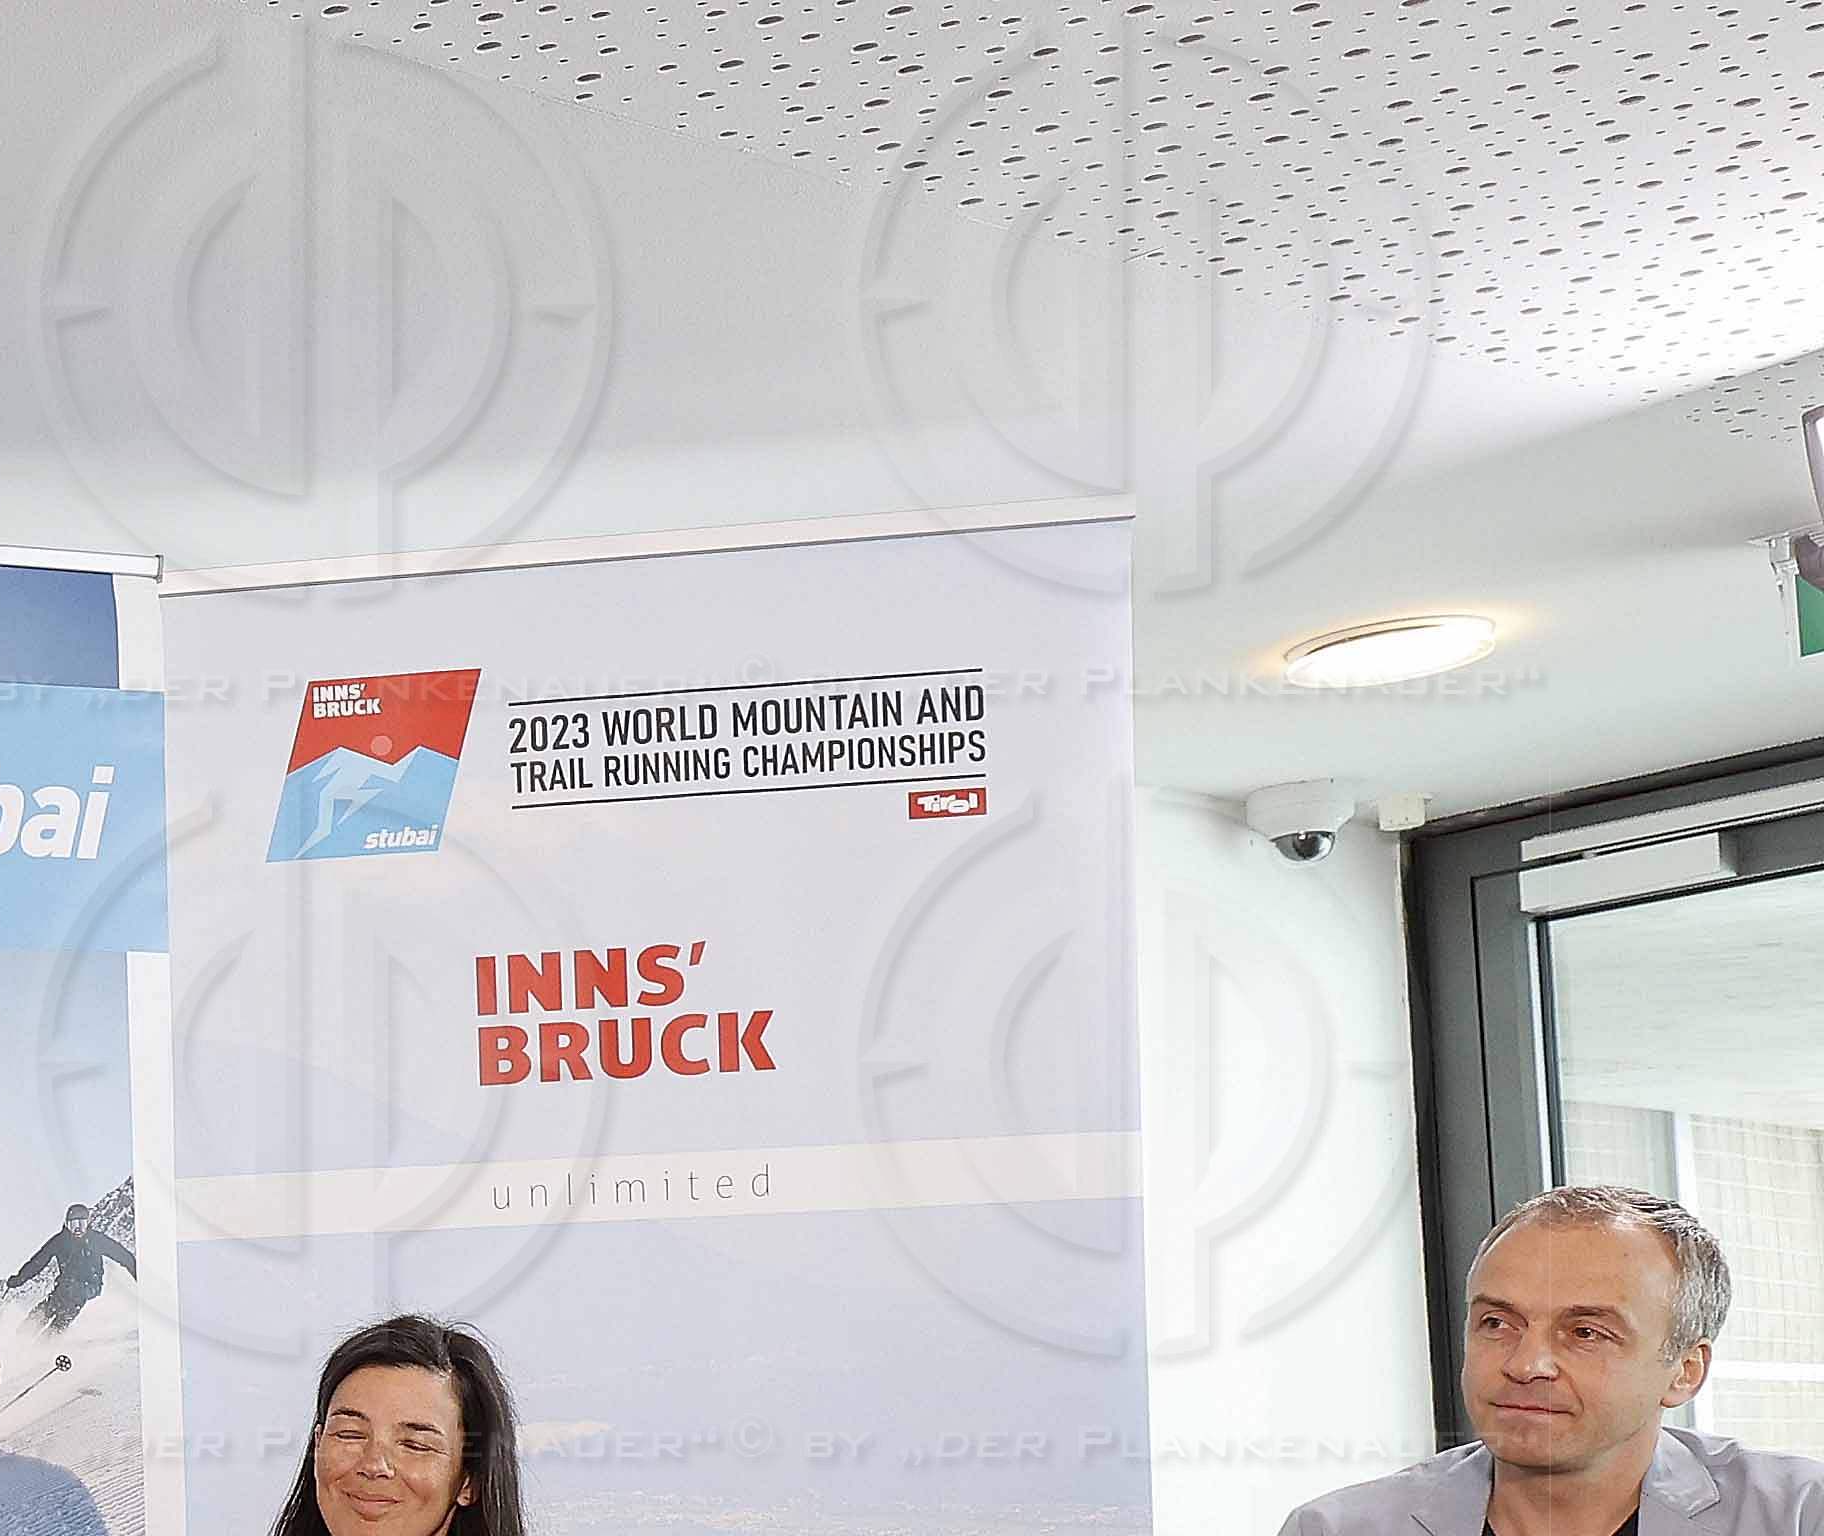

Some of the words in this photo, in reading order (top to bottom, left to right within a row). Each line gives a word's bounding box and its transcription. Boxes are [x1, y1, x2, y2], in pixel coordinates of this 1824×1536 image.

[313, 699, 383, 719] BRUCK
[508, 713, 590, 753] 2023
[602, 704, 717, 746] WORLD
[732, 690, 902, 738] MOUNTAIN
[916, 685, 985, 724] AND
[510, 759, 592, 794] TRAIL
[604, 747, 730, 787] RUNNING
[743, 730, 986, 777] CHAMPIONSHIPS
[363, 825, 439, 849] stubai
[477, 1009, 777, 1086] BRUCK
[493, 1164, 774, 1211] unlimited
